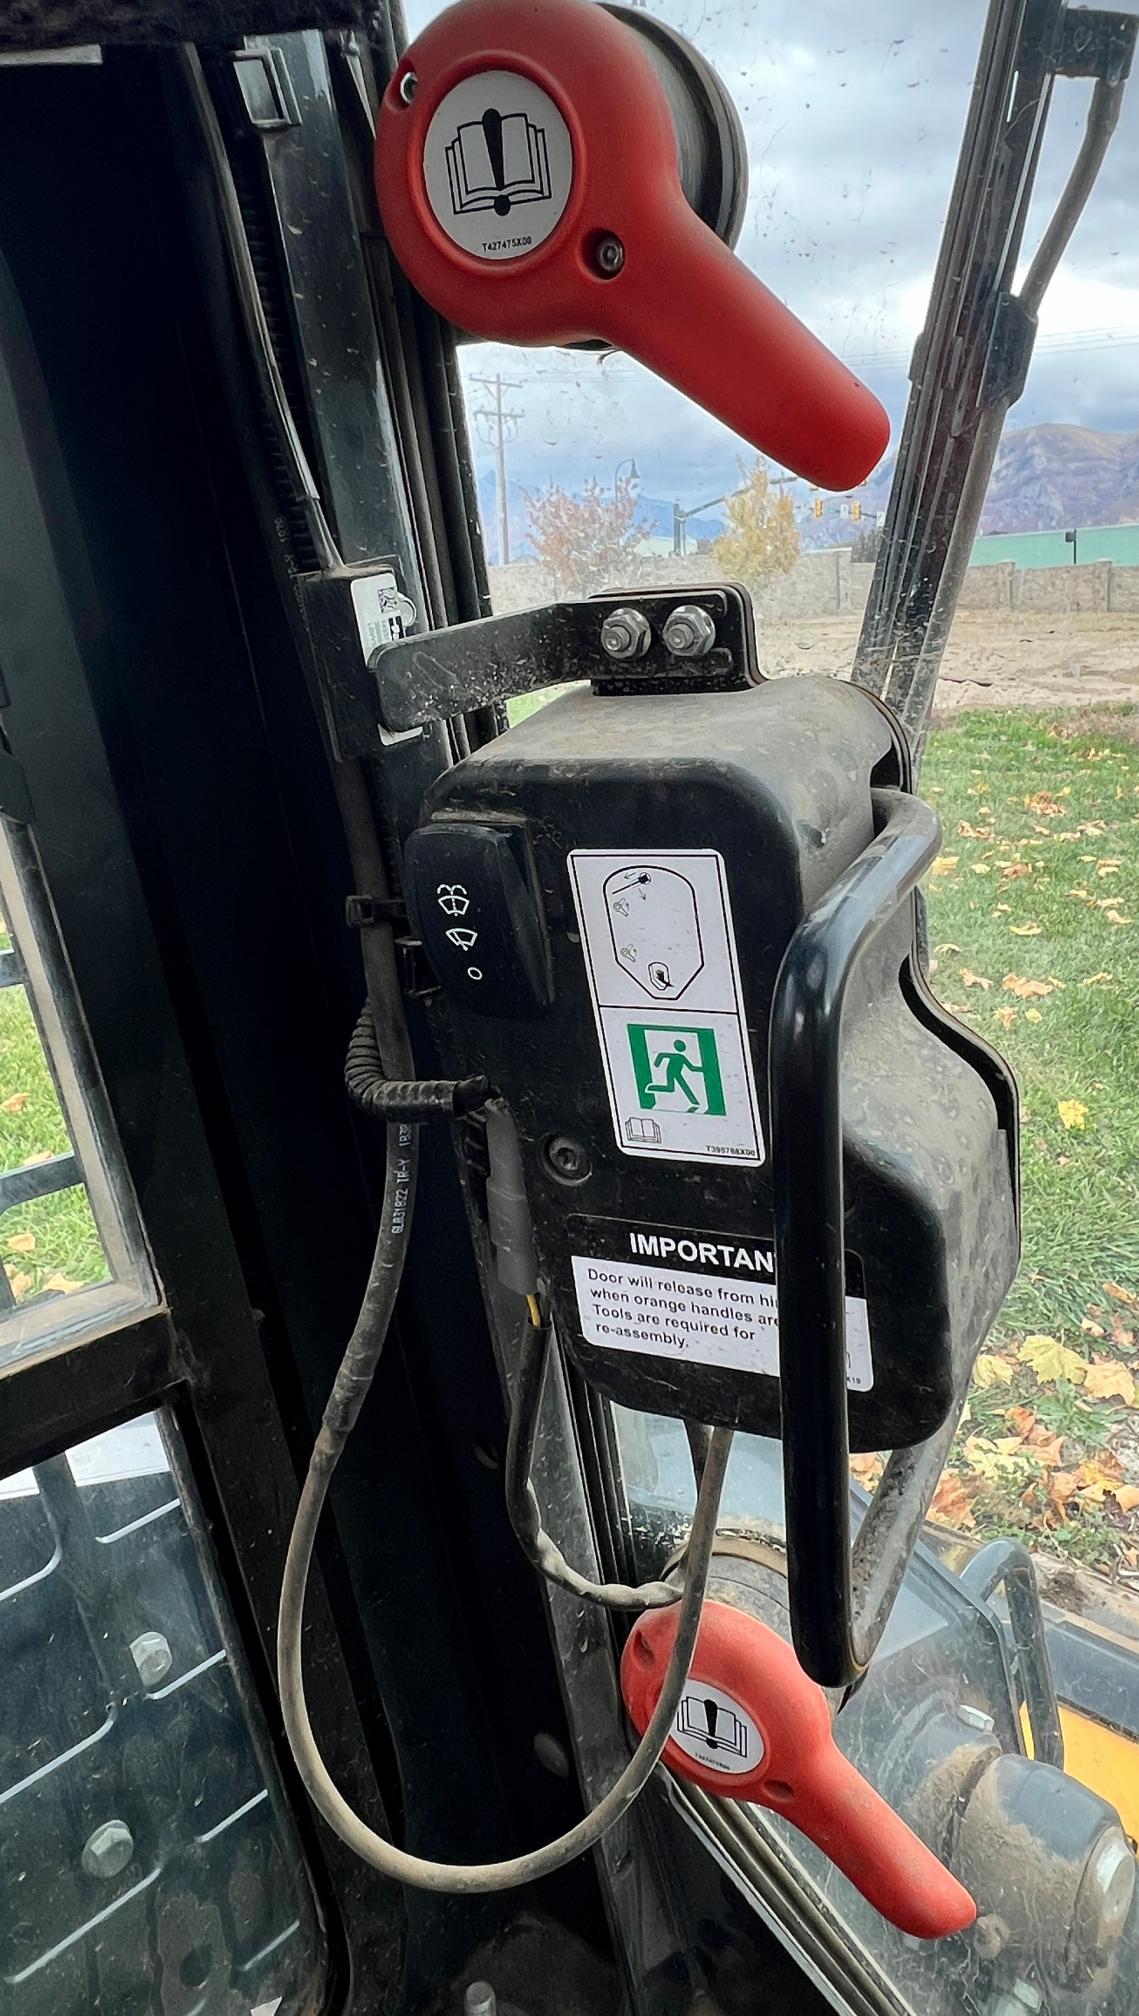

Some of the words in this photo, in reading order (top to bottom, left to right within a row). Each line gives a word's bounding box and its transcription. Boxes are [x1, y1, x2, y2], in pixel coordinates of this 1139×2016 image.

[482, 236, 532, 252] T427475X00
[629, 1232, 777, 1273] IMPORTAN
[588, 1268, 623, 1284] Door
[628, 1276, 653, 1289] will
[658, 1281, 713, 1298] release
[718, 1288, 755, 1305] from
[590, 1288, 629, 1303] when
[634, 1295, 686, 1313] orange
[691, 1301, 752, 1323] handles
[593, 1304, 633, 1321] Tools
[637, 1313, 660, 1325] are
[665, 1317, 728, 1337] required
[734, 1327, 755, 1341] for
[596, 1323, 689, 1349] re-assembly.
